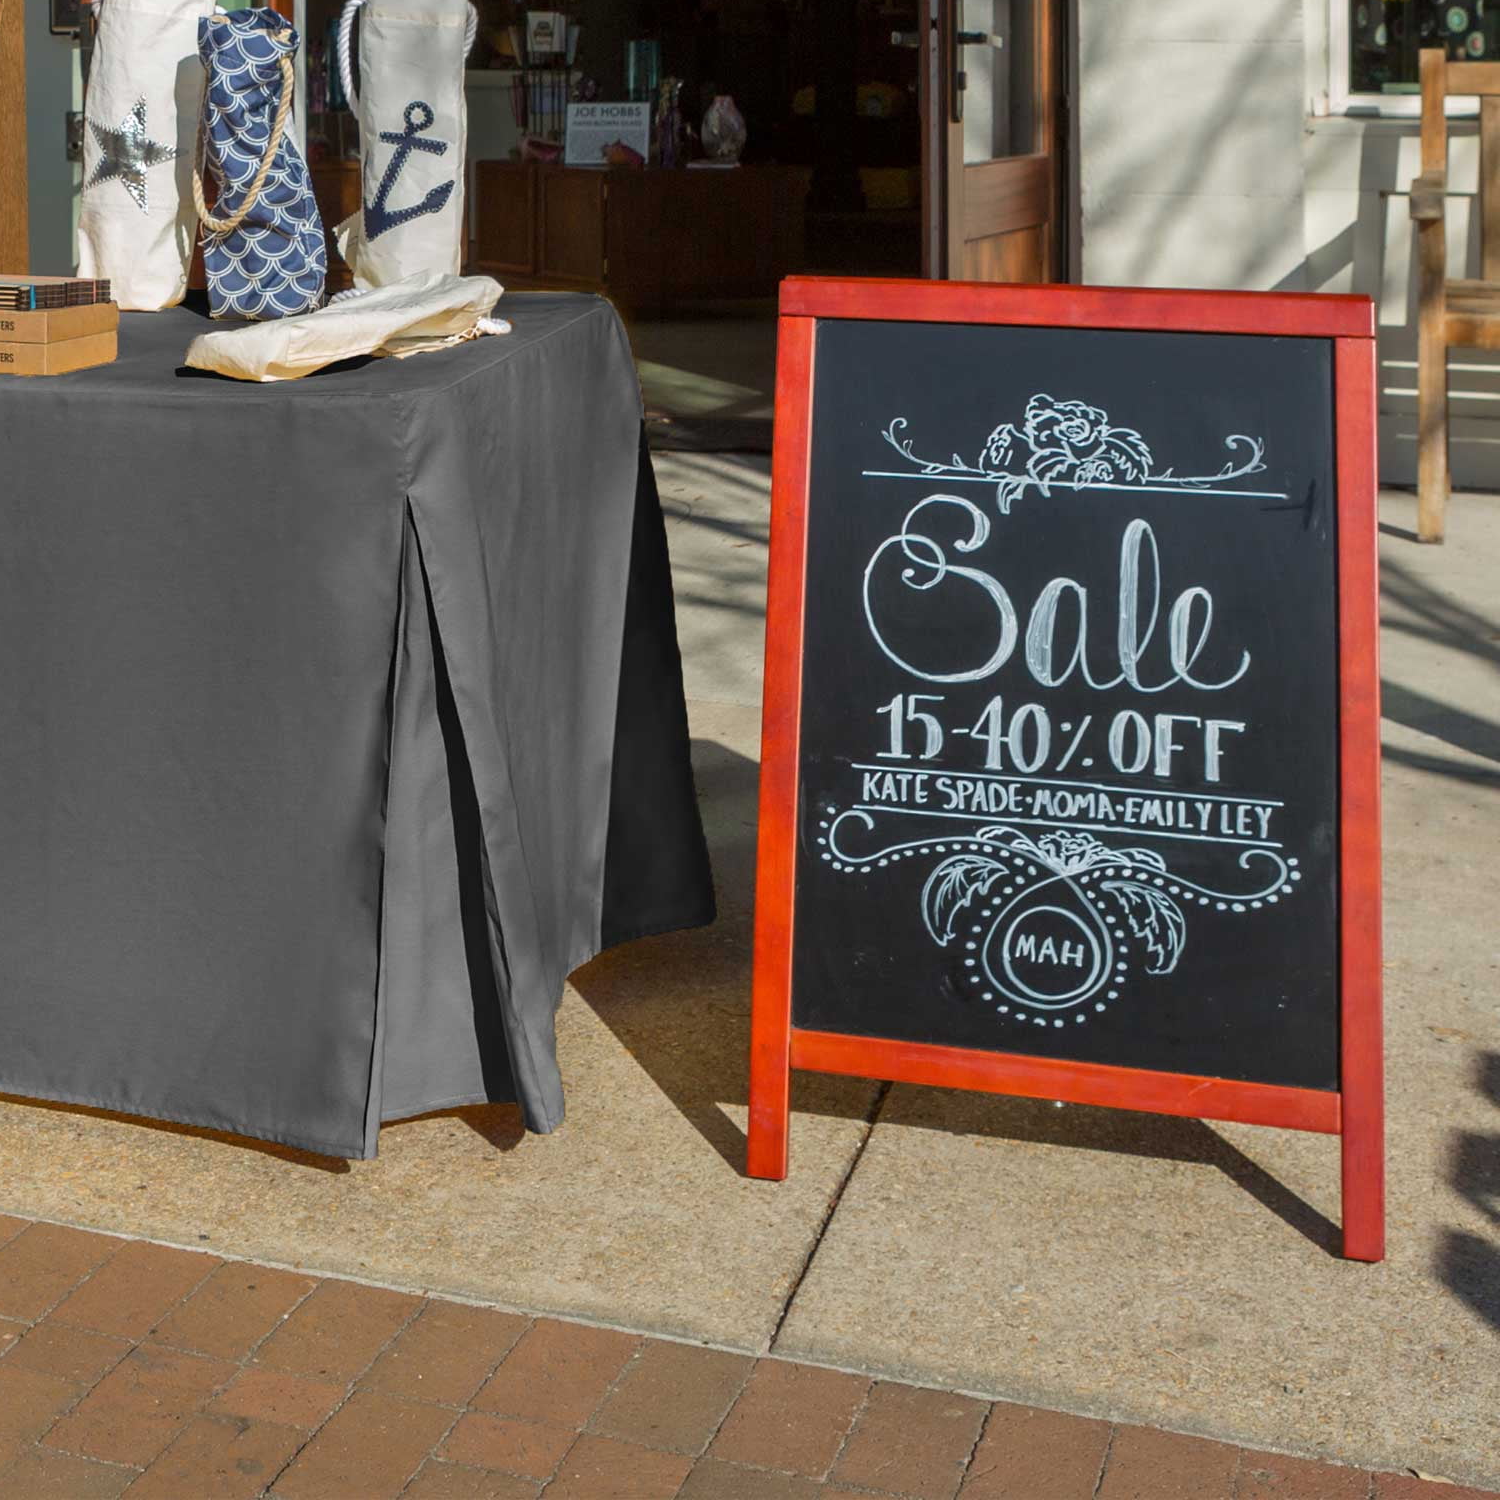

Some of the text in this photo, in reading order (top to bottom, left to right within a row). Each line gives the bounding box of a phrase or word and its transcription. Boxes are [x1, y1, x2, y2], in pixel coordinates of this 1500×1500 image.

[575, 106, 642, 117] JOE HOBBS
[861, 494, 1250, 693] Sale
[1108, 710, 1246, 782] OFF
[862, 772, 928, 804] KATE
[1221, 804, 1273, 839] LEY
[1015, 934, 1085, 967] MAH
